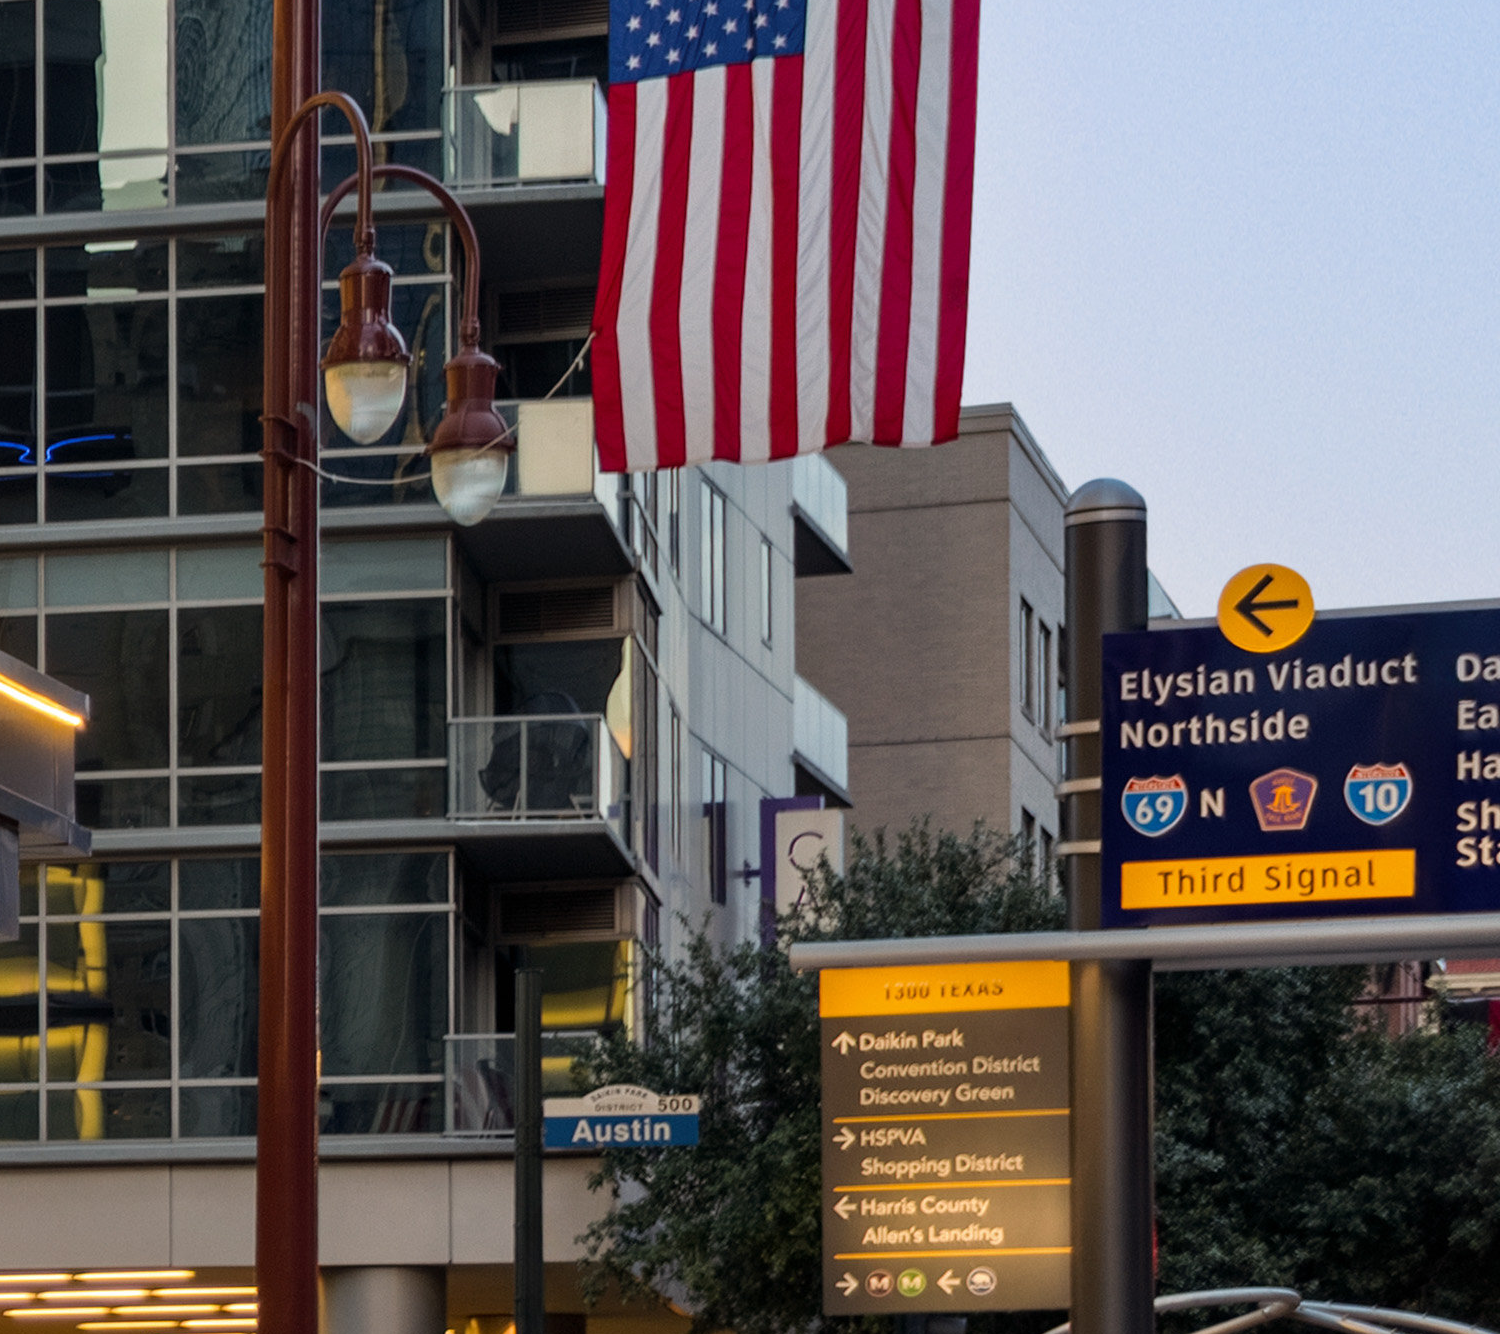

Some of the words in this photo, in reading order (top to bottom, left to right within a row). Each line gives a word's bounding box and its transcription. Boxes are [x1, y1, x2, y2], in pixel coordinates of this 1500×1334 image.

[1121, 665, 1254, 706] Elysian
[1267, 652, 1417, 691] Viaduct
[1120, 709, 1310, 749] Northside
[1135, 794, 1174, 826] 69
[1200, 787, 1225, 817] N
[1358, 782, 1399, 813] 10
[1456, 835, 1500, 868] St
[1158, 866, 1245, 896] Third
[1265, 859, 1376, 896] Signal
[939, 978, 1004, 998] TEXAS
[859, 1030, 918, 1052] Daikin
[921, 1028, 965, 1049] Park
[860, 1058, 967, 1080] Convention
[972, 1054, 1041, 1075] District
[657, 1097, 693, 1113] 500
[859, 1085, 952, 1107] Discovery
[954, 1082, 1015, 1103] Green
[571, 1117, 672, 1143] Austin
[860, 1126, 927, 1147] HSPVA
[860, 1155, 951, 1180] Shopping
[955, 1152, 1025, 1174] District
[860, 1196, 917, 1217] Harris
[920, 1194, 990, 1217] County
[861, 1225, 924, 1246] Allen's
[928, 1222, 1004, 1246] Landing
